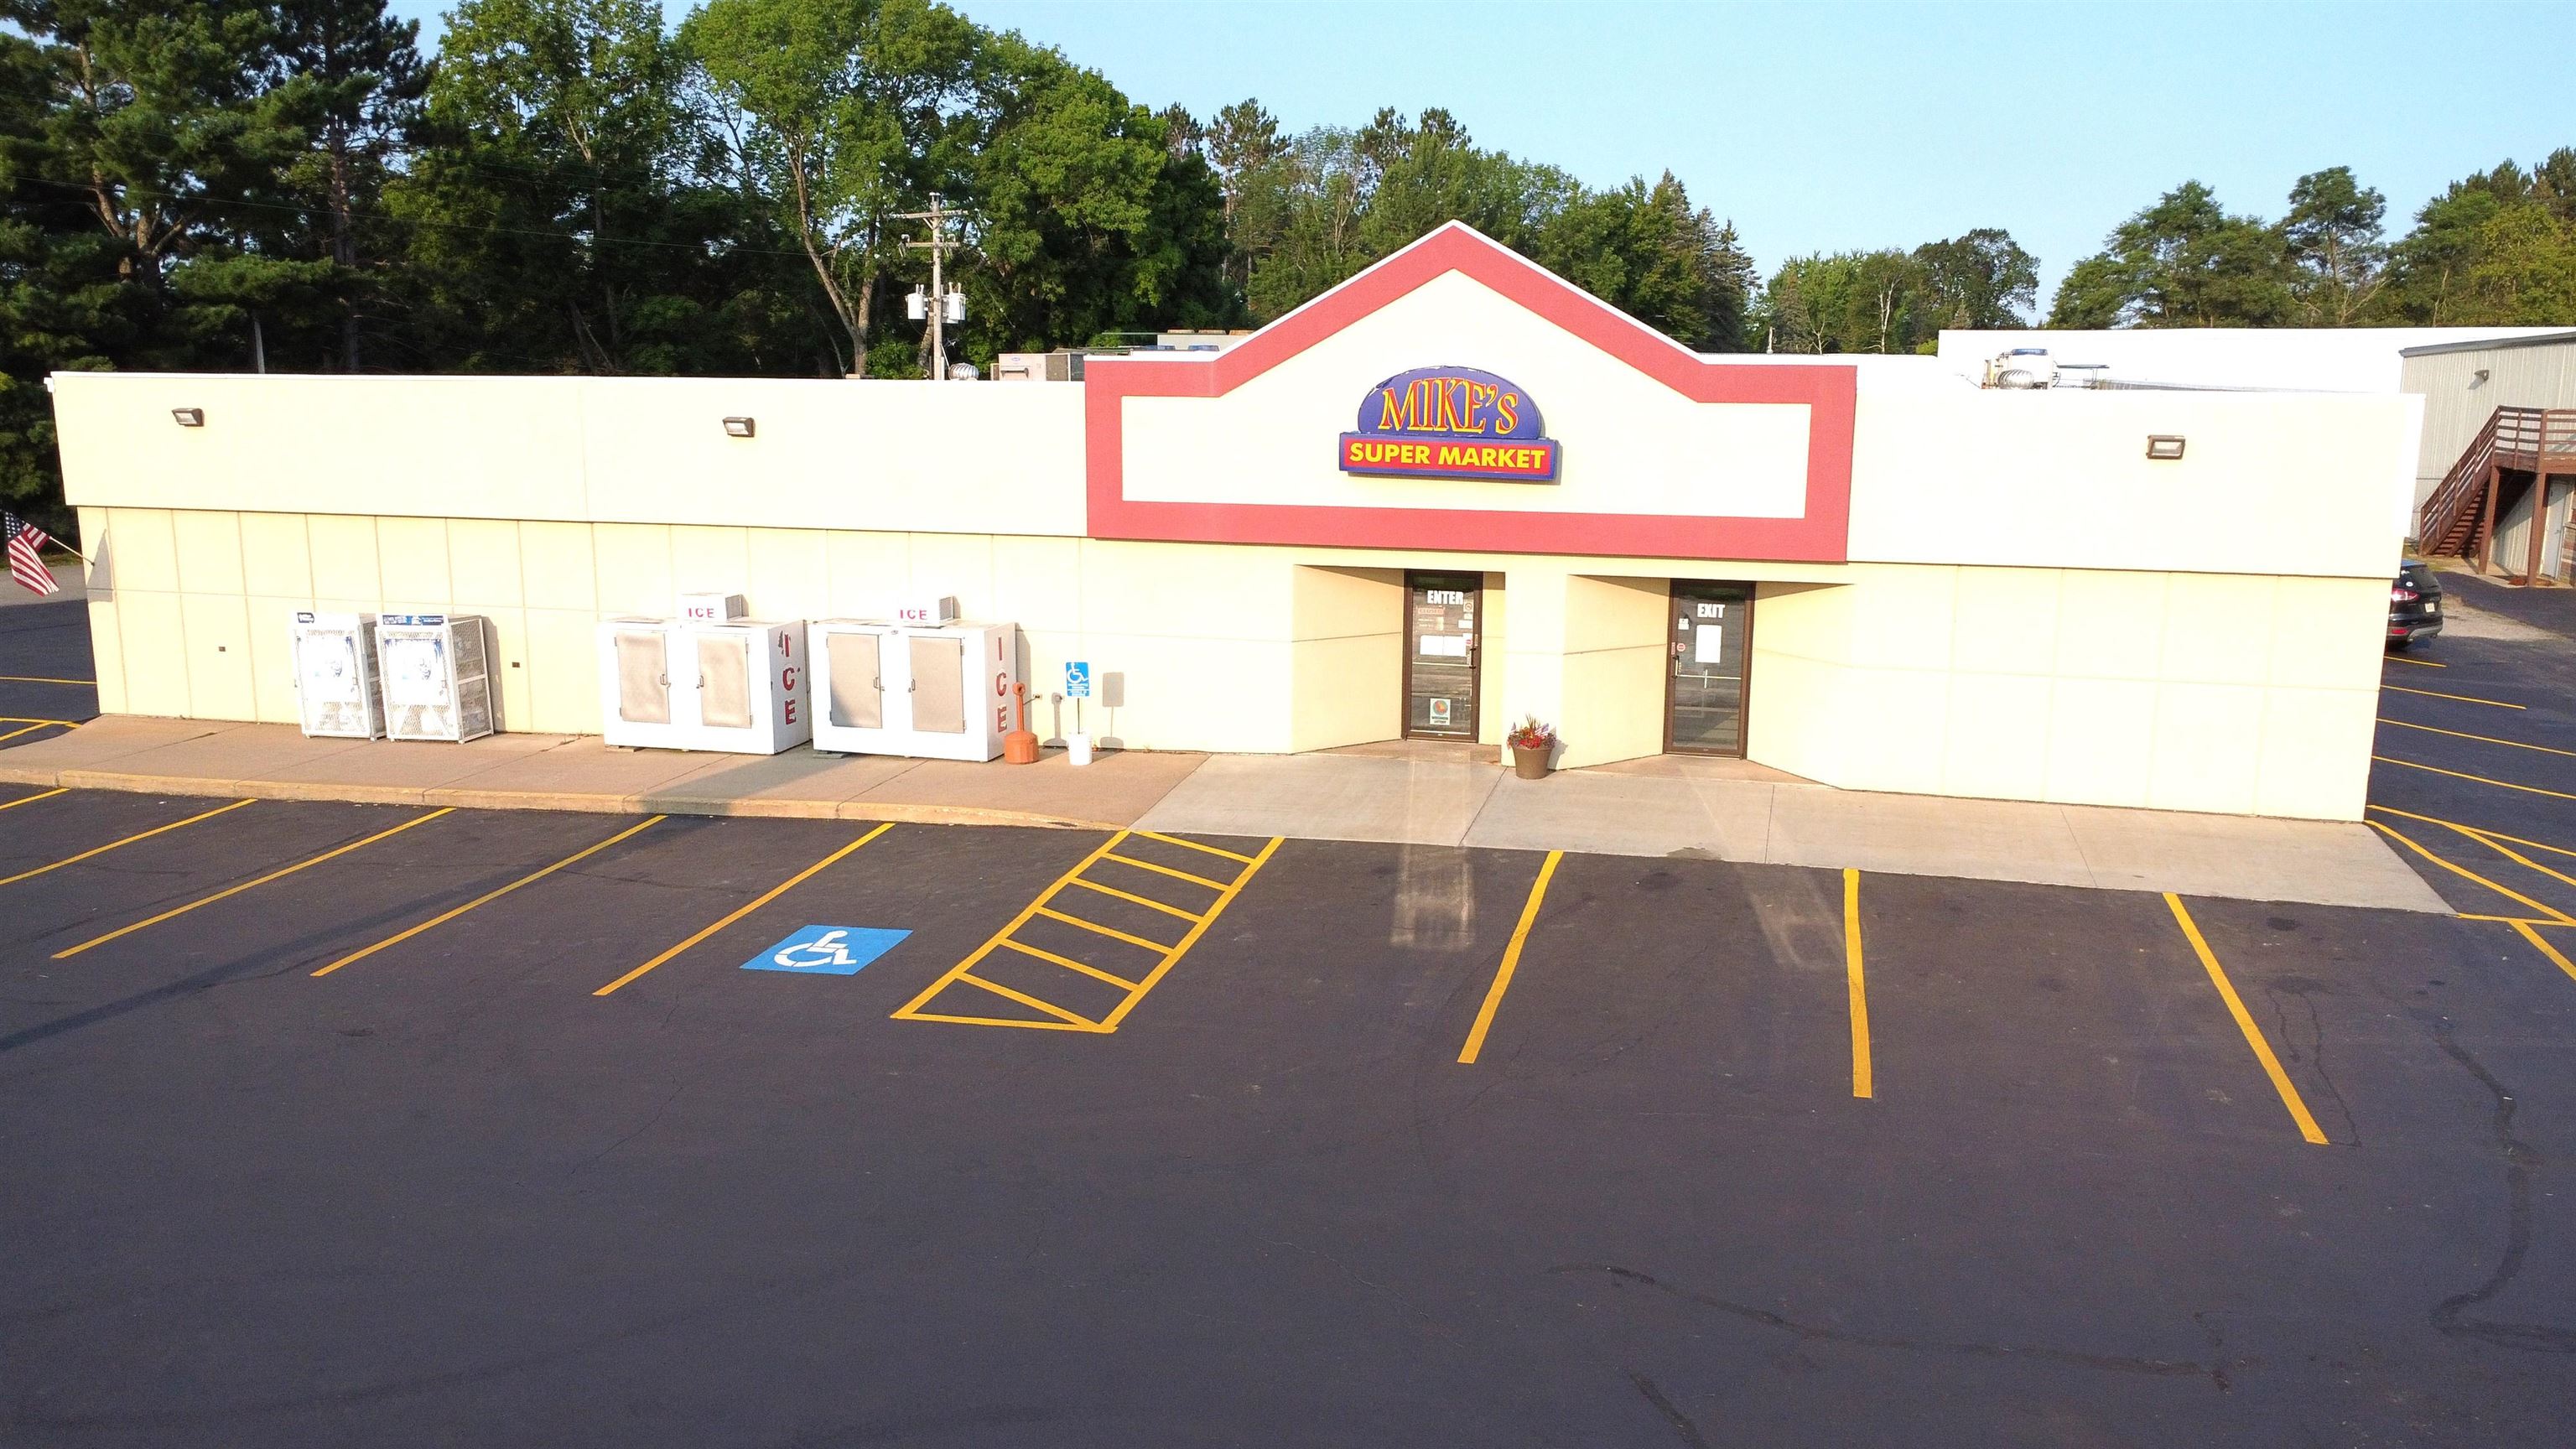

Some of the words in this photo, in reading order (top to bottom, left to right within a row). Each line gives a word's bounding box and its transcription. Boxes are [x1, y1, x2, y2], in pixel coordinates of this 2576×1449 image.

[1378, 377, 1519, 434] MIKE'S
[1349, 442, 1431, 465] SUPER
[1436, 446, 1545, 470] MARKET
[1426, 590, 1464, 605] ENTER
[688, 607, 715, 619] ICE
[899, 609, 928, 621] ICE
[1696, 603, 1726, 619] EXIT
[782, 633, 797, 725] ICE
[995, 636, 1008, 734] ICE
